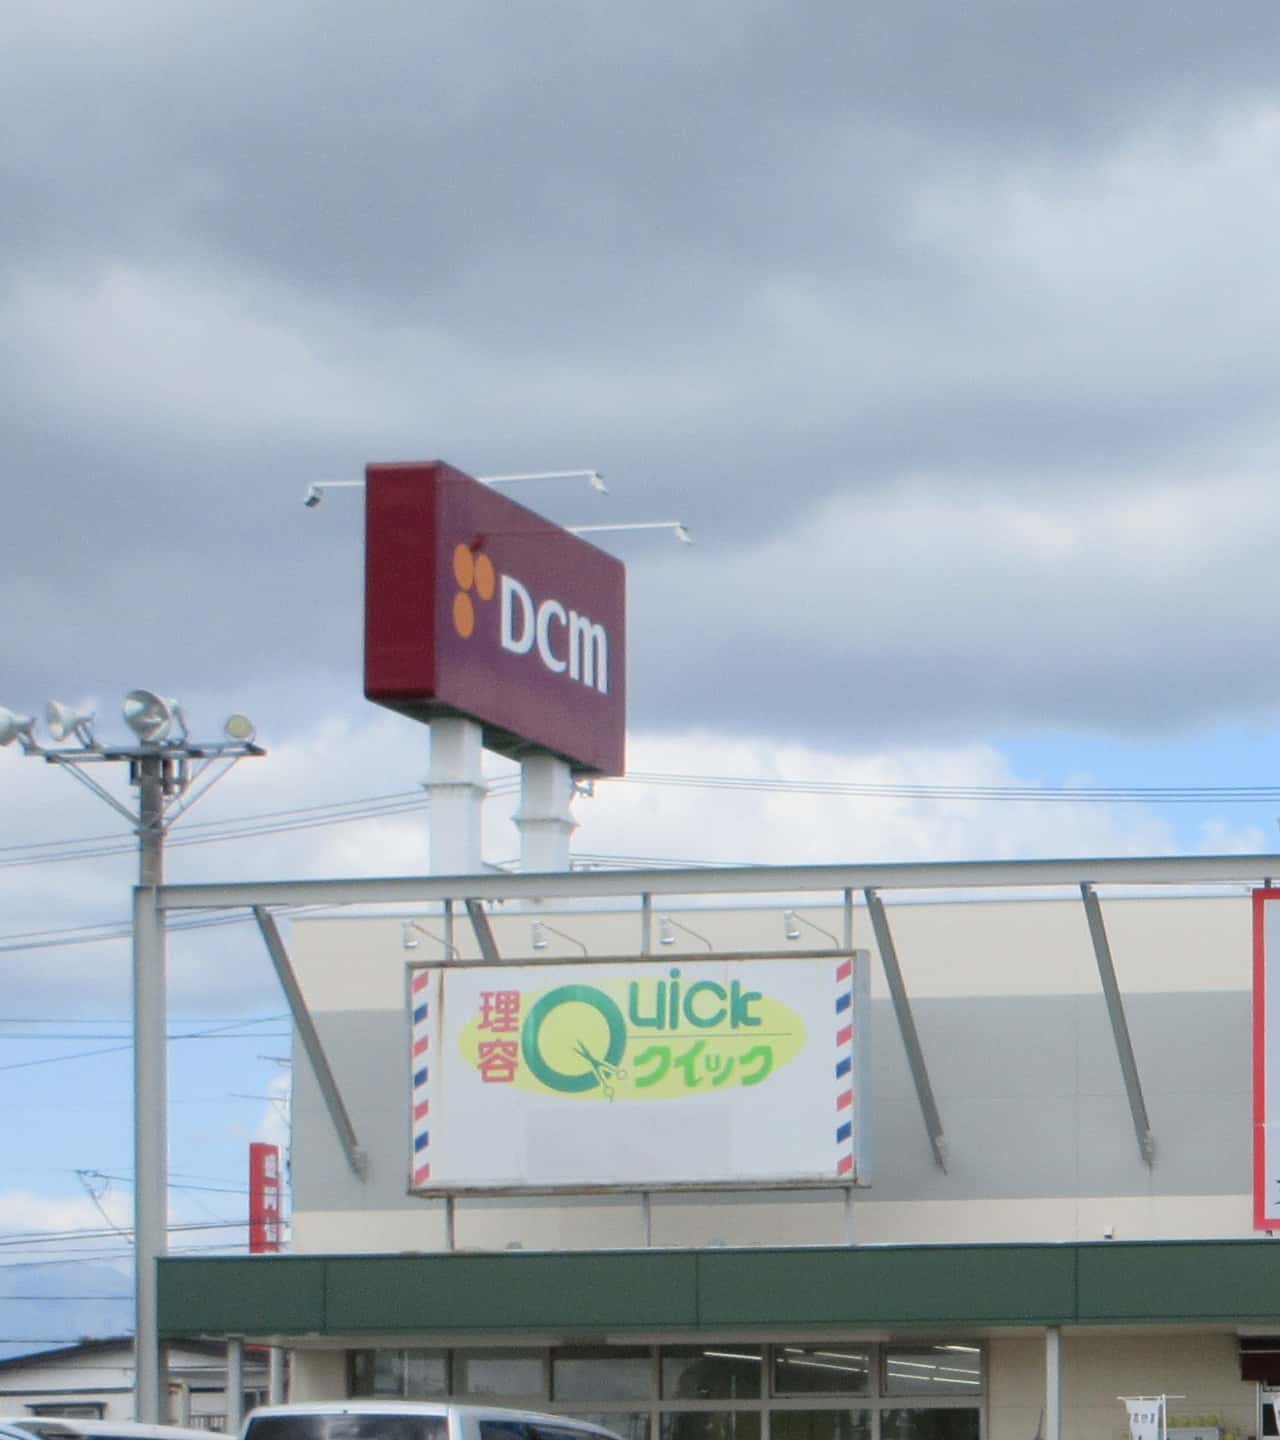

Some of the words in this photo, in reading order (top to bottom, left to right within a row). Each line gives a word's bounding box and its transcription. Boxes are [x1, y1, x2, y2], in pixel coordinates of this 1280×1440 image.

[478, 990, 519, 1083] 理容
[633, 1040, 774, 1088] クイック
